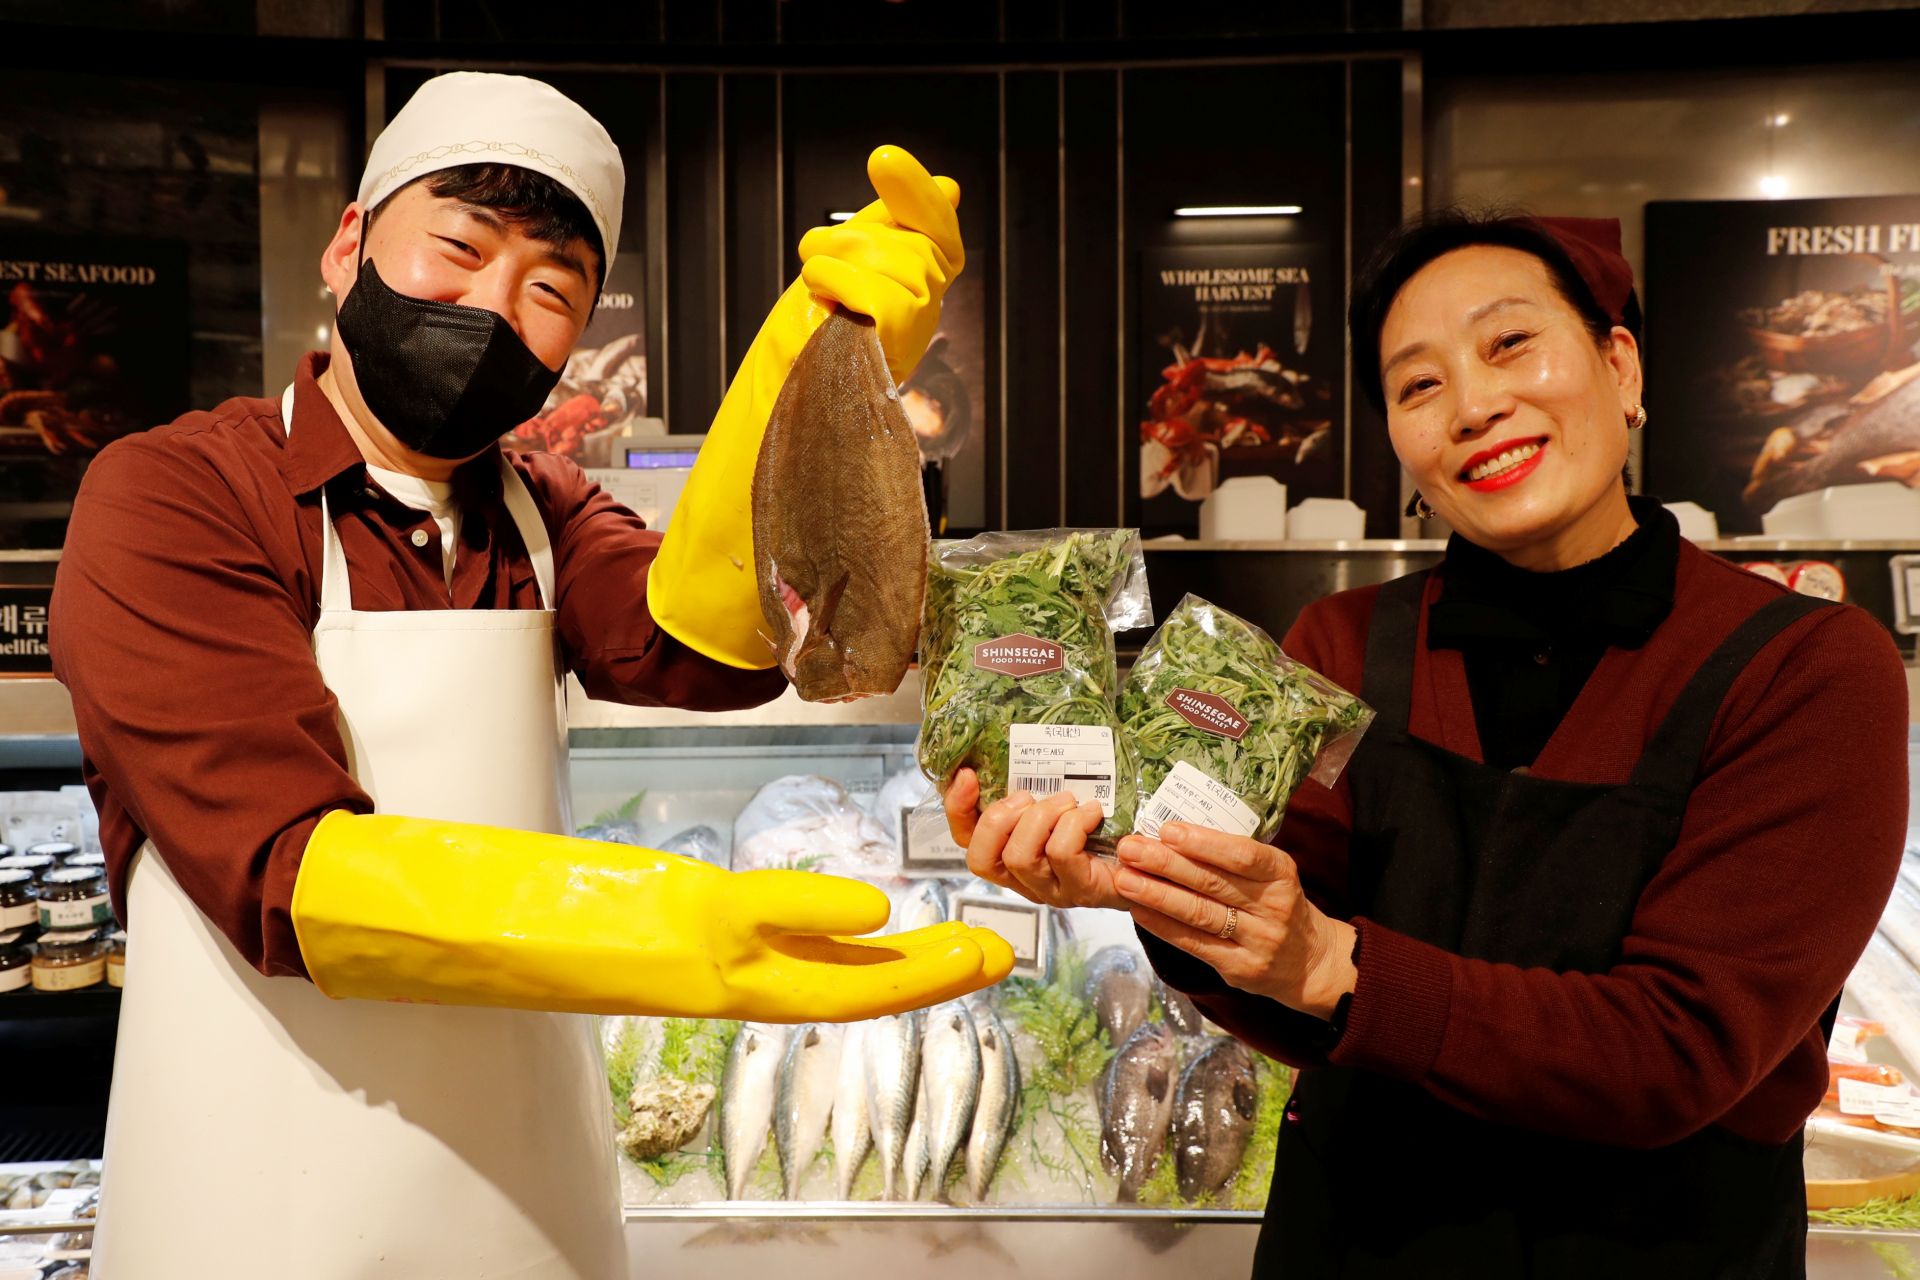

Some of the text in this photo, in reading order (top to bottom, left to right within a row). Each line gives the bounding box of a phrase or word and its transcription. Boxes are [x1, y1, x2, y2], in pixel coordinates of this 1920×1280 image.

[1767, 225, 1880, 255] FRESH
[44, 262, 156, 286] SEAFOOD
[1160, 267, 1310, 286] WHOLESOME SEA
[1195, 284, 1275, 302] HARVEST
[982, 647, 1055, 659] SHINSEGAE
[1176, 693, 1241, 730] SHINSEGAE
[1180, 703, 1229, 730] FOOD MARKET
[1094, 784, 1110, 799] 3950
